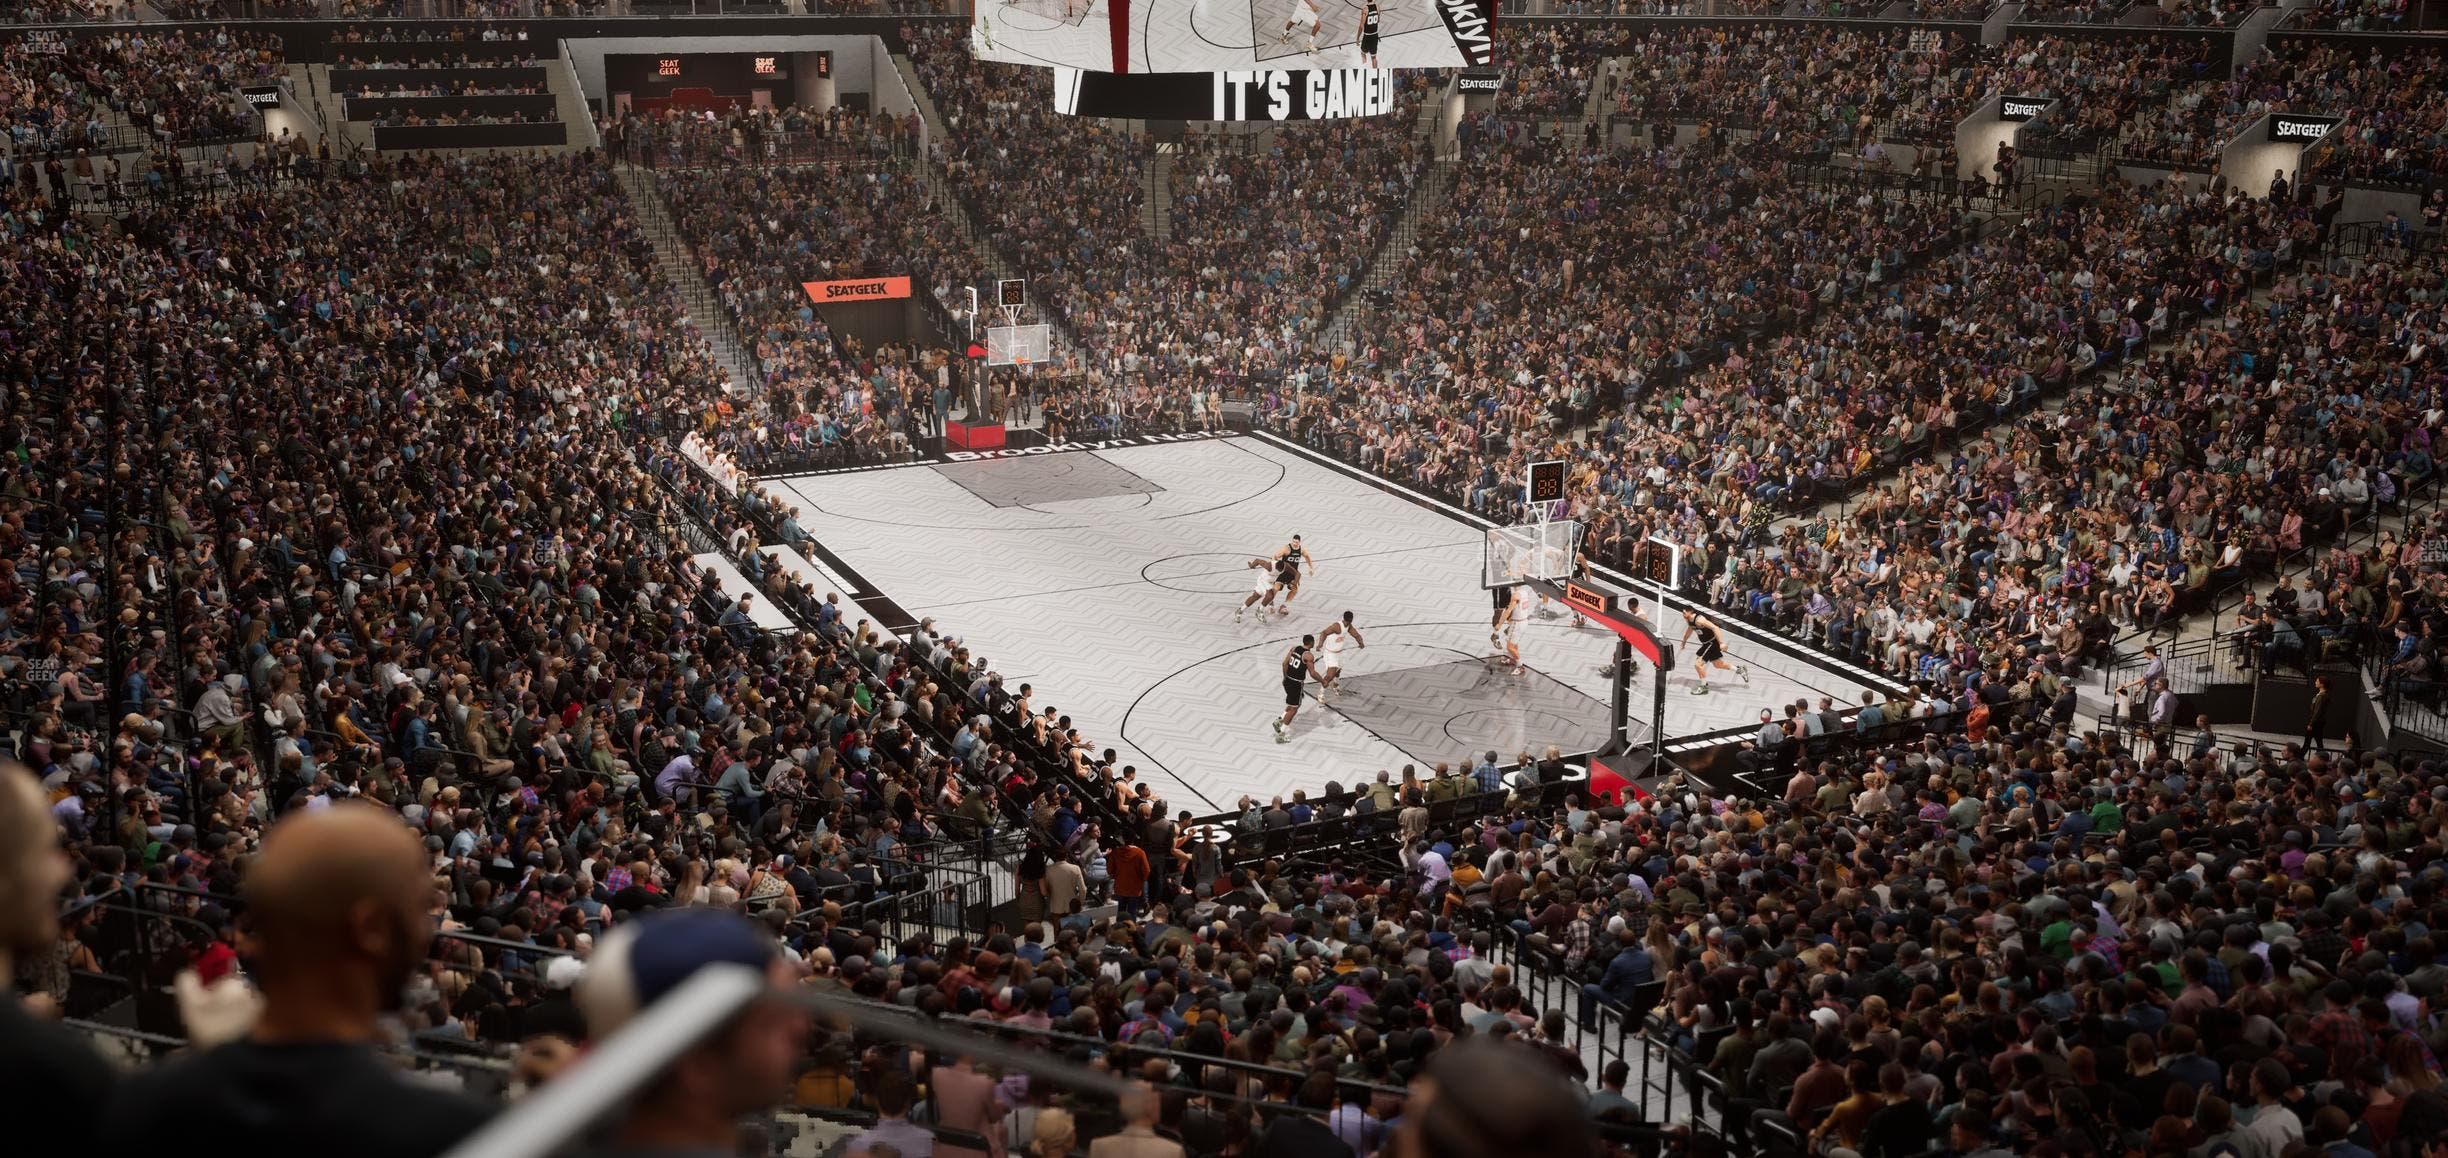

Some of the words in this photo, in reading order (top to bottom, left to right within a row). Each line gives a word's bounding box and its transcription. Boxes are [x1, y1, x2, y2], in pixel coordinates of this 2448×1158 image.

[660, 60, 680, 68] SEAT
[1460, 79, 1500, 89] SEATGEEK
[1213, 69, 1290, 121] IT'S
[2277, 121, 2331, 138] SEATGEEK
[826, 282, 888, 298] SEATGEEK
[945, 439, 1138, 461] Brooklyn
[1537, 479, 1557, 496] 88
[1571, 587, 1600, 609] SEATGEEK
